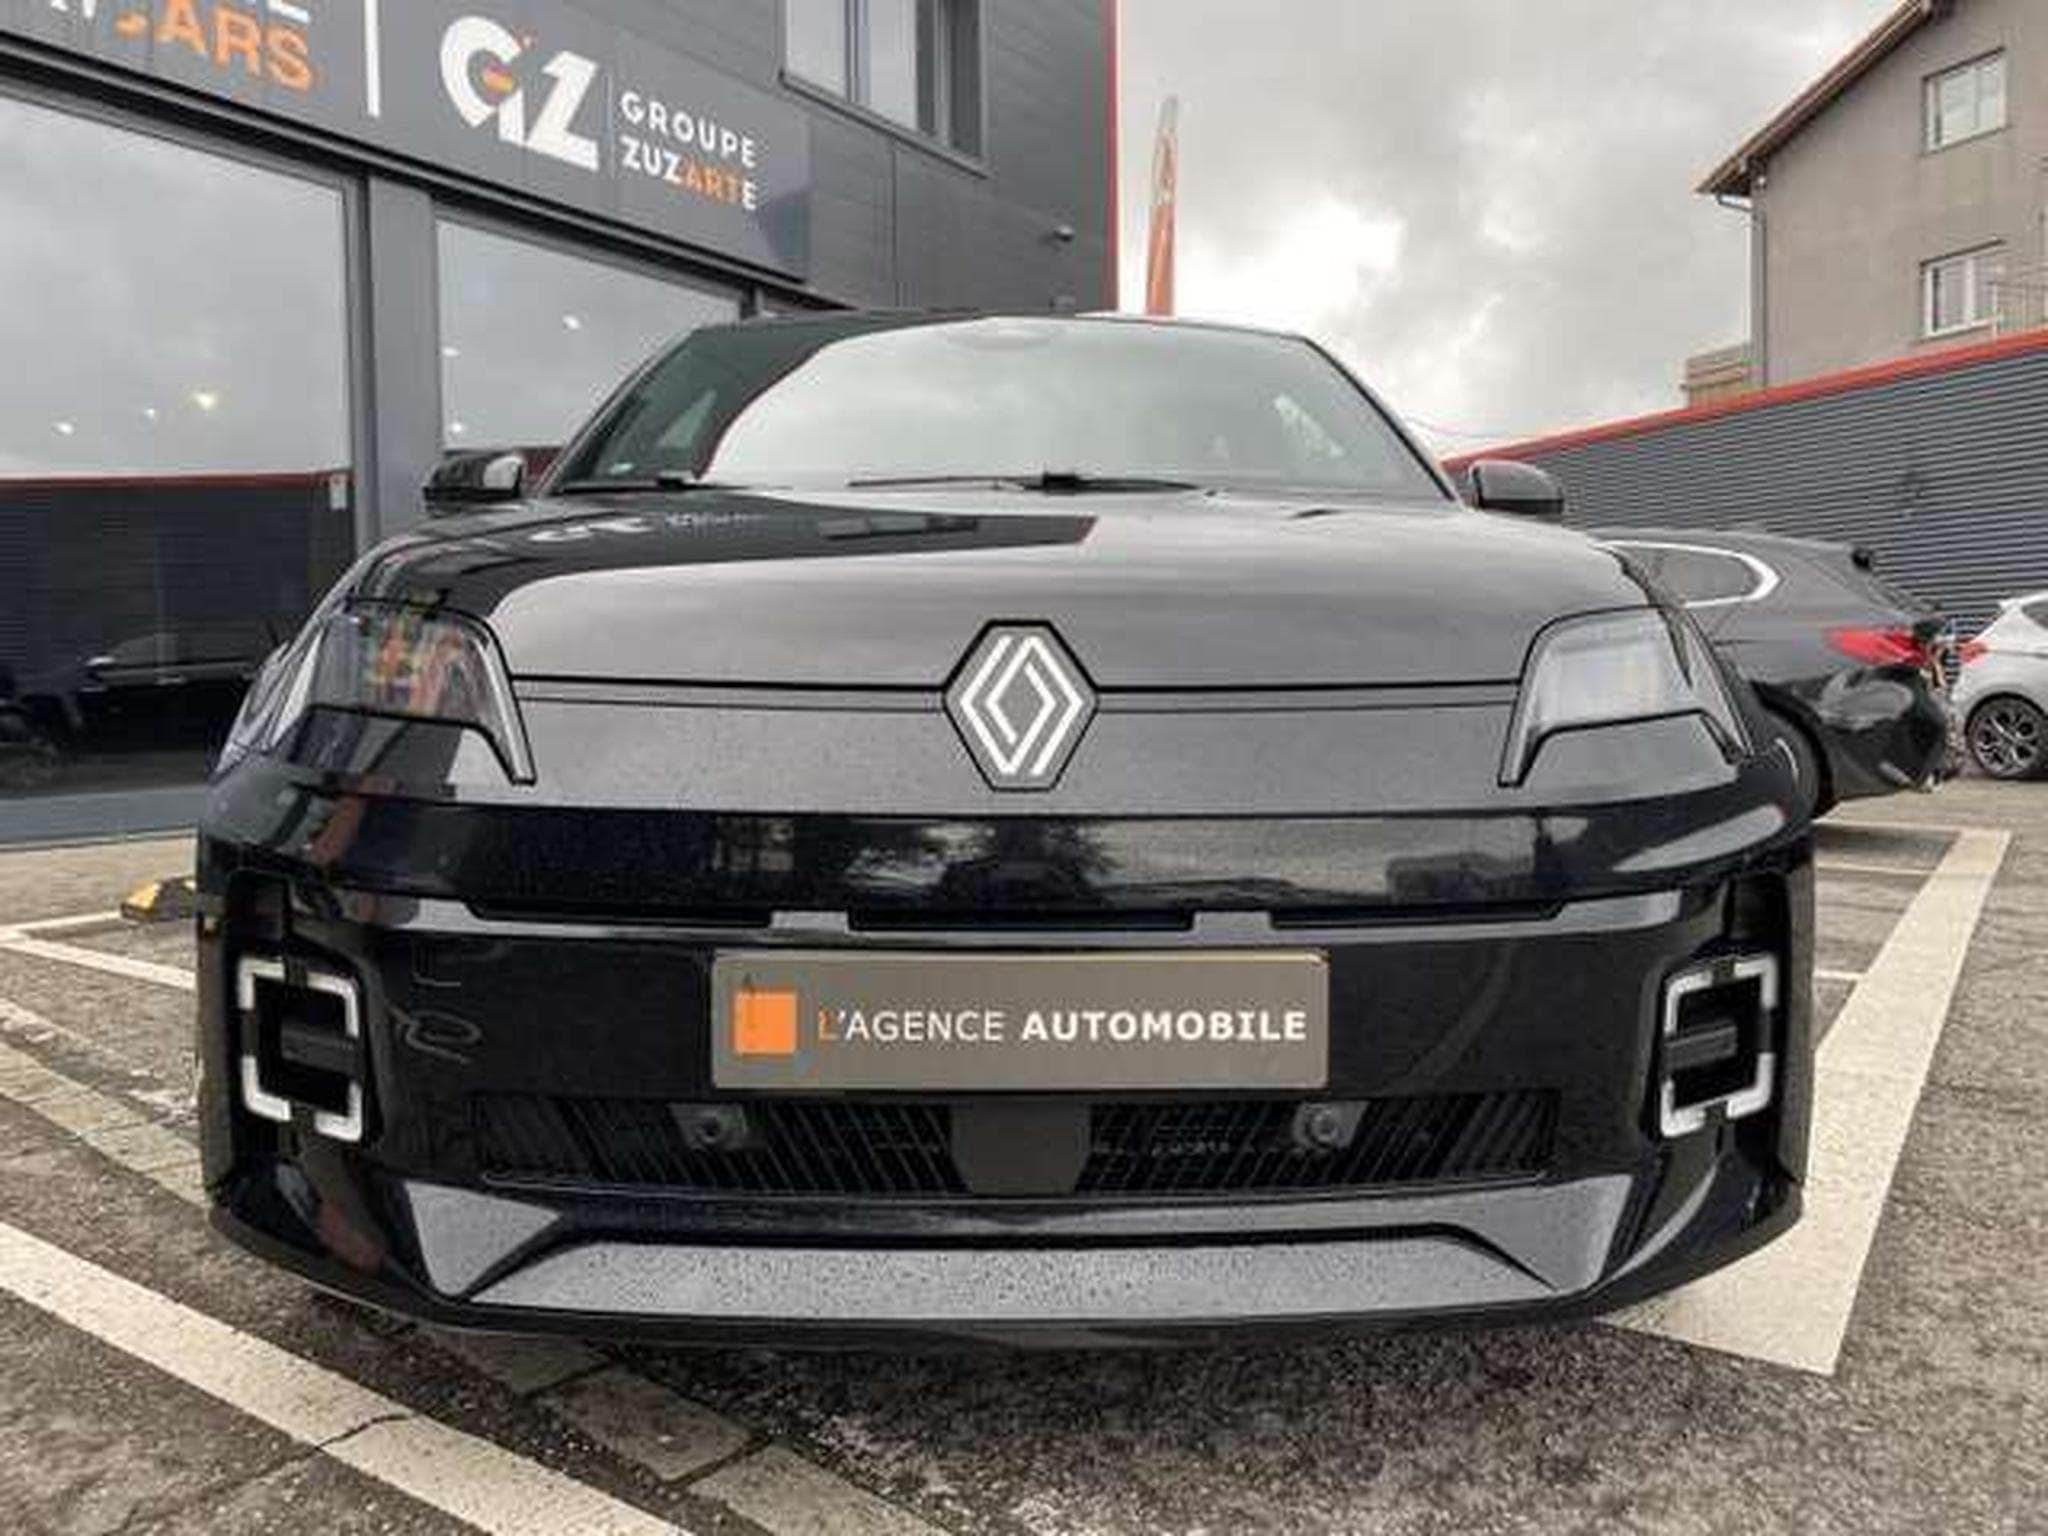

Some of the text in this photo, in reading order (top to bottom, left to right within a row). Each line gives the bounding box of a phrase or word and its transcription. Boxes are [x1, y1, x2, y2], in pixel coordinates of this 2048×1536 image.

[620, 91, 758, 168] GROUPE
[619, 135, 758, 210] ZUZARTE
[818, 1009, 1307, 1042] L'AGENCE AUTOMOBILE
